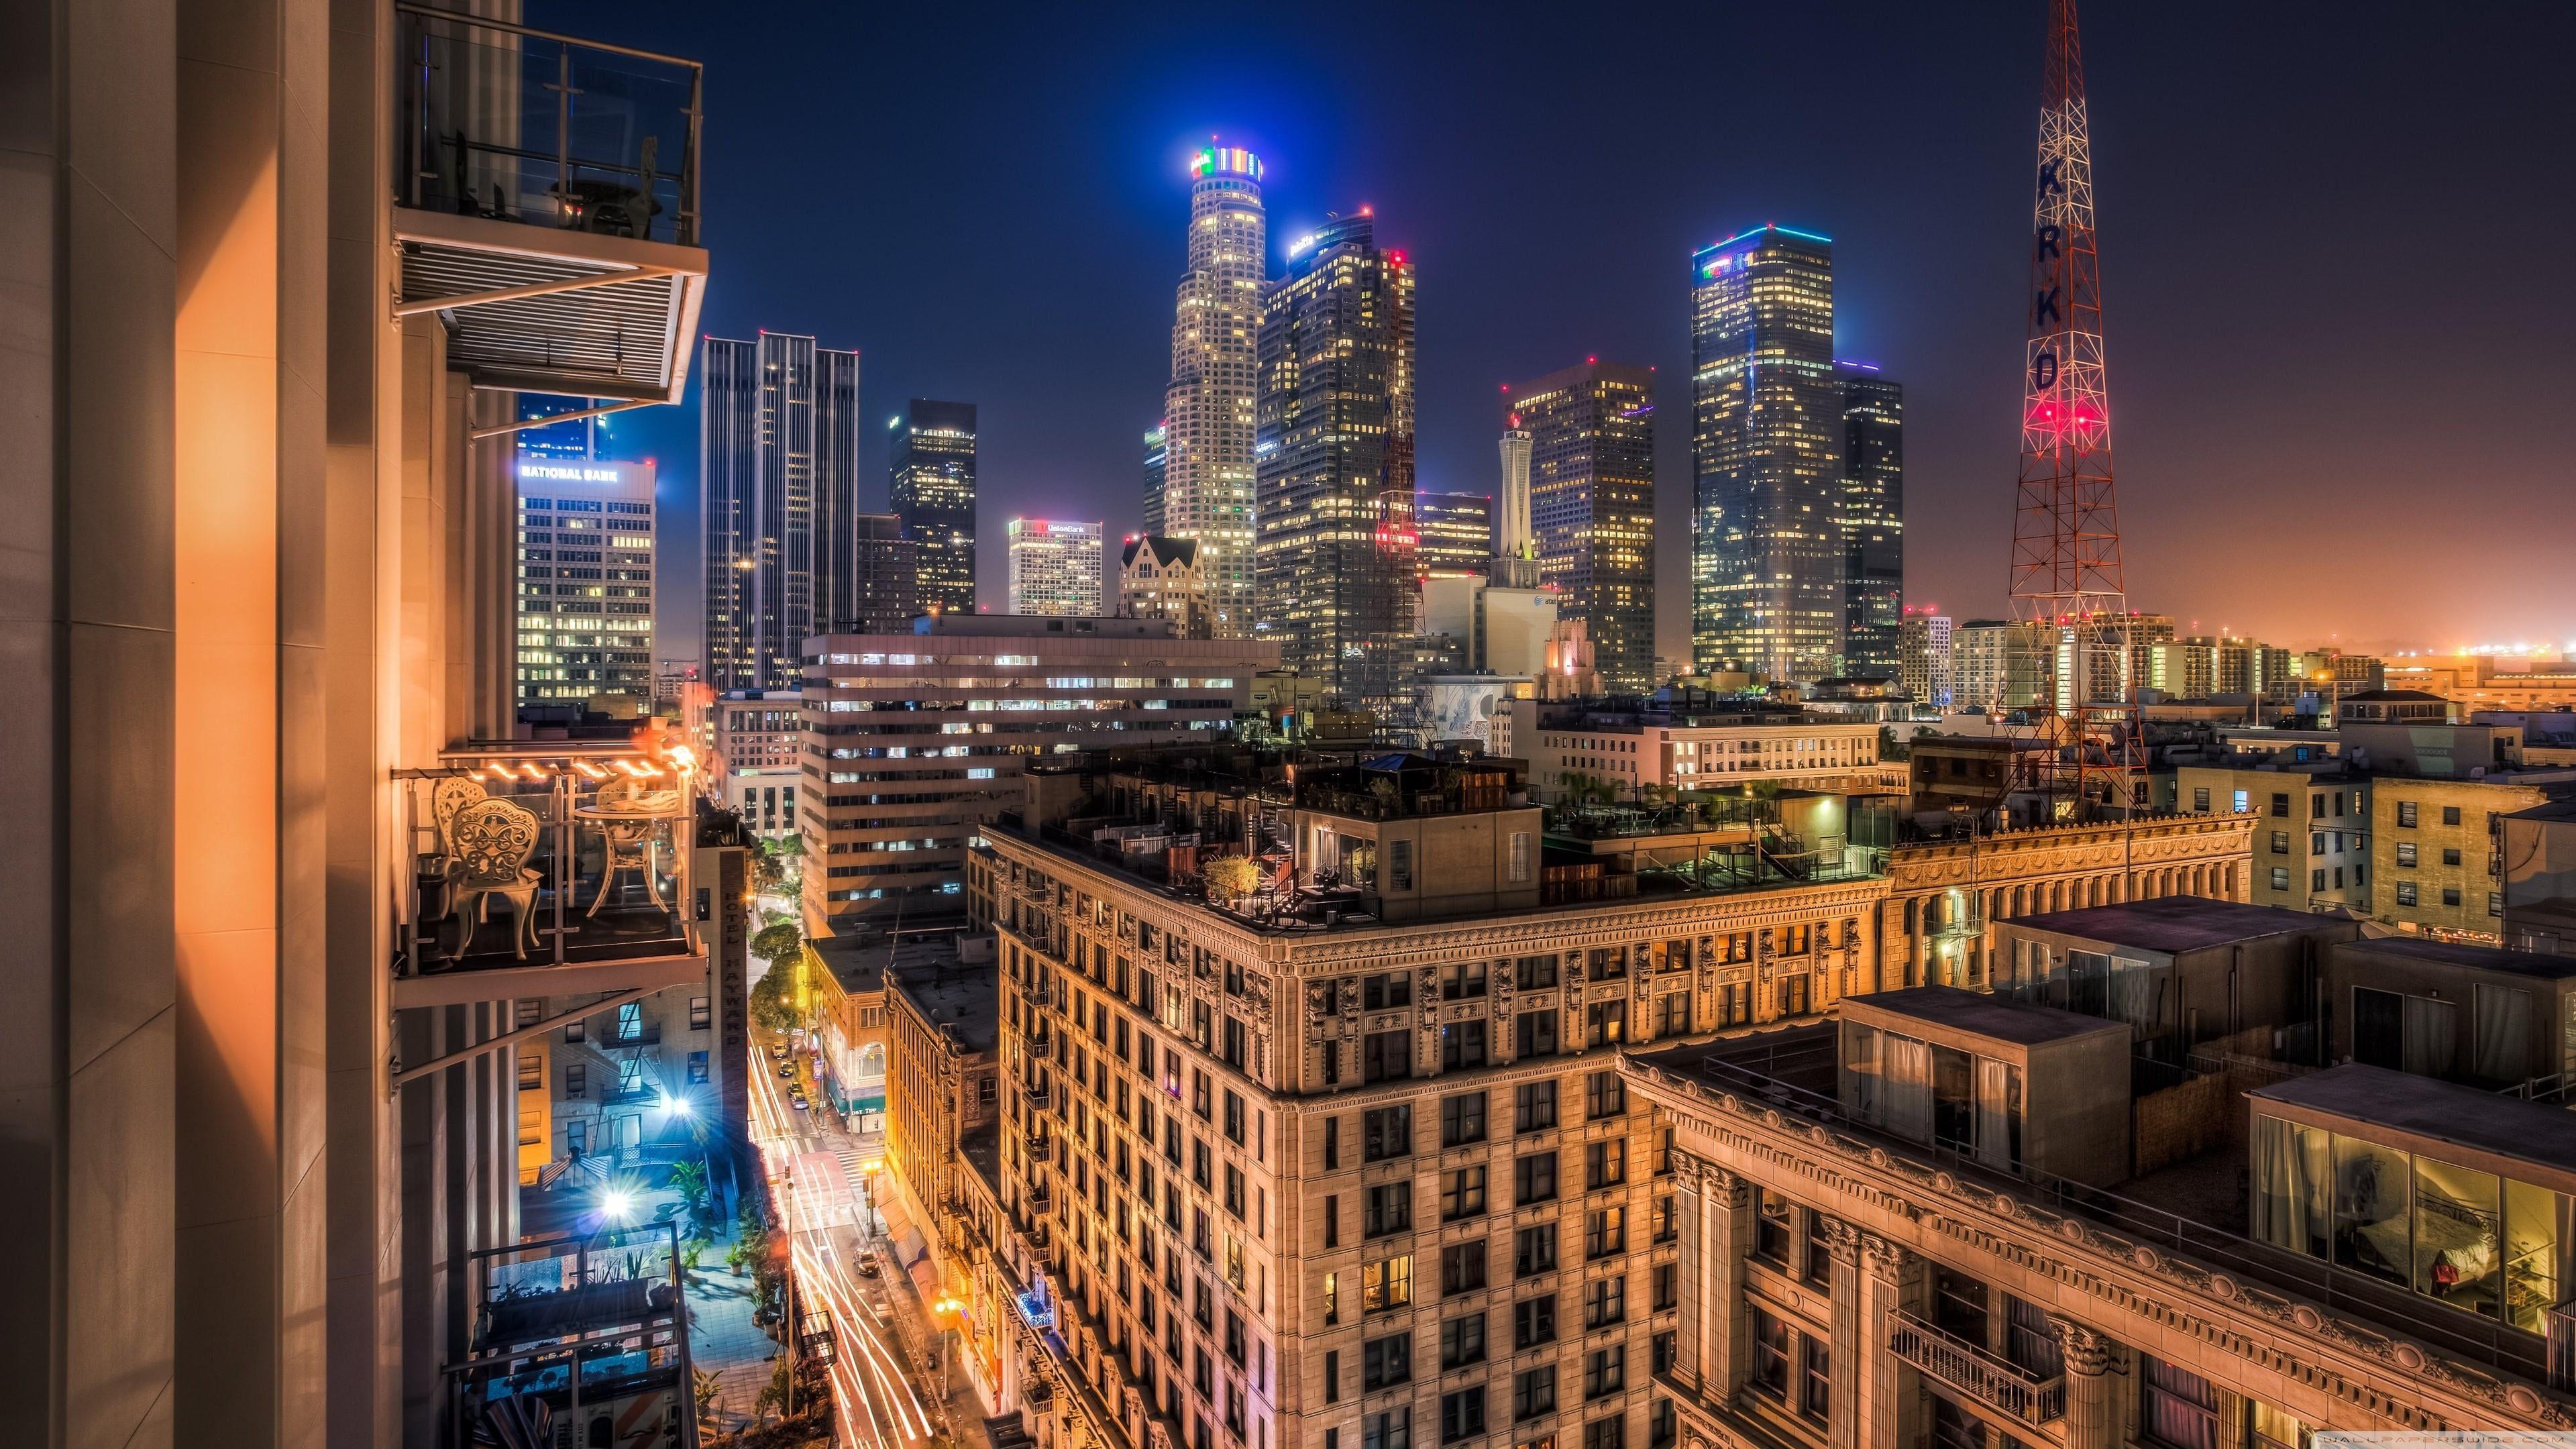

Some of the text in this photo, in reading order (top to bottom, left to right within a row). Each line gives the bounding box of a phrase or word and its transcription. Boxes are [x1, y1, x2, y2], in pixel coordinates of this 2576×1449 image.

[2036, 158, 2062, 390] KRKD
[521, 466, 618, 482] NATIONAL BANK
[724, 892, 741, 1046] HOTEL HAYWARD
